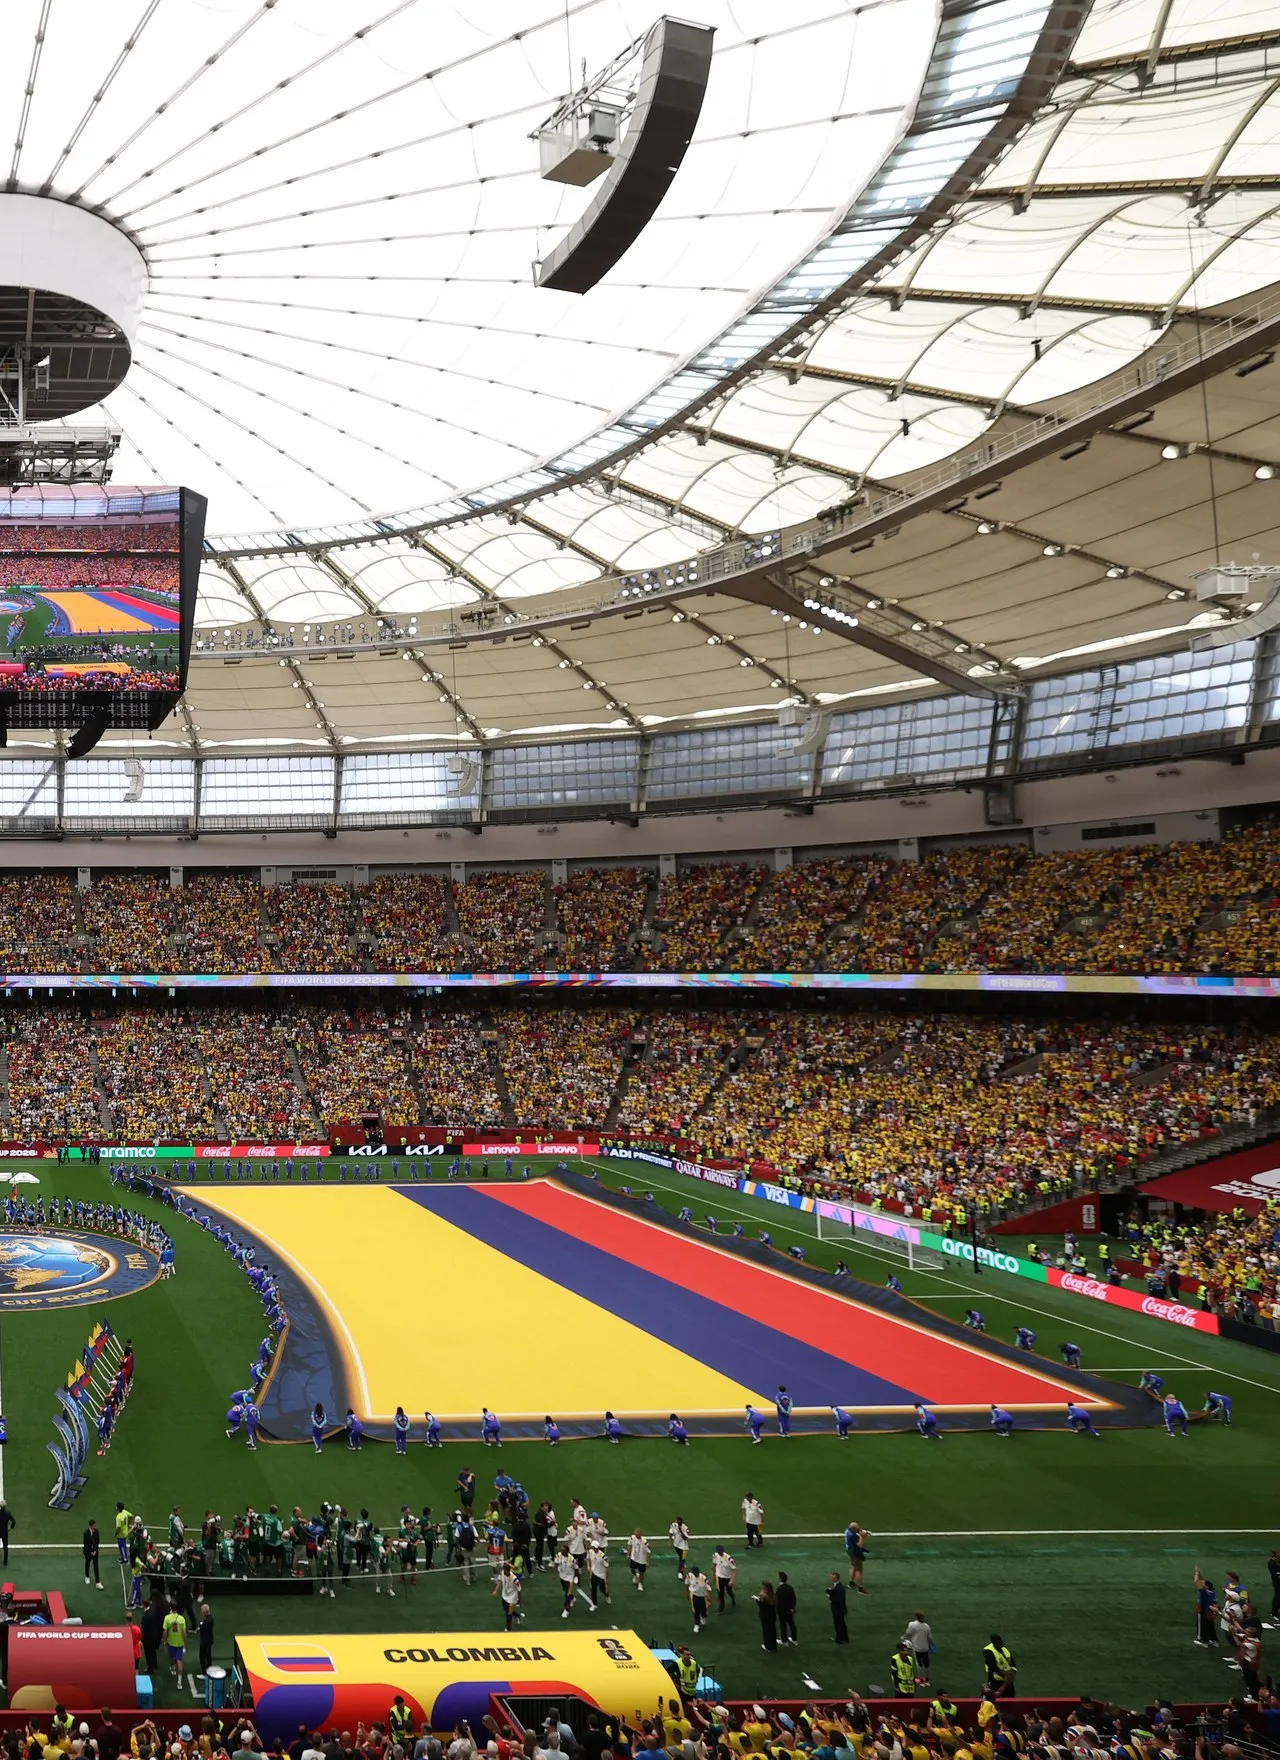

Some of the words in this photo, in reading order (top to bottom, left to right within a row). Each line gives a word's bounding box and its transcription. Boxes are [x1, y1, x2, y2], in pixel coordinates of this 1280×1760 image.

[275, 976, 297, 984] FIFA
[297, 976, 331, 984] WORLD
[333, 976, 353, 984] CUP
[354, 976, 389, 984] 2026
[447, 1129, 465, 1137] FIFA
[99, 1147, 156, 1158] aramco
[348, 1145, 387, 1156] KIA
[405, 1145, 444, 1156] KIA
[481, 1144, 520, 1155] Lenovo
[537, 1144, 578, 1155] Lenovo
[609, 1148, 632, 1158] ADI
[675, 1160, 701, 1180] QATAR
[703, 1170, 738, 1189] AIRWAYS
[763, 1185, 790, 1206] VISA
[941, 1238, 1019, 1274] aramco
[48, 1288, 109, 1303] 2026
[16, 1631, 37, 1639] FIFA
[38, 1631, 70, 1639] WORLD
[383, 1647, 556, 1663] COLOMBIA
